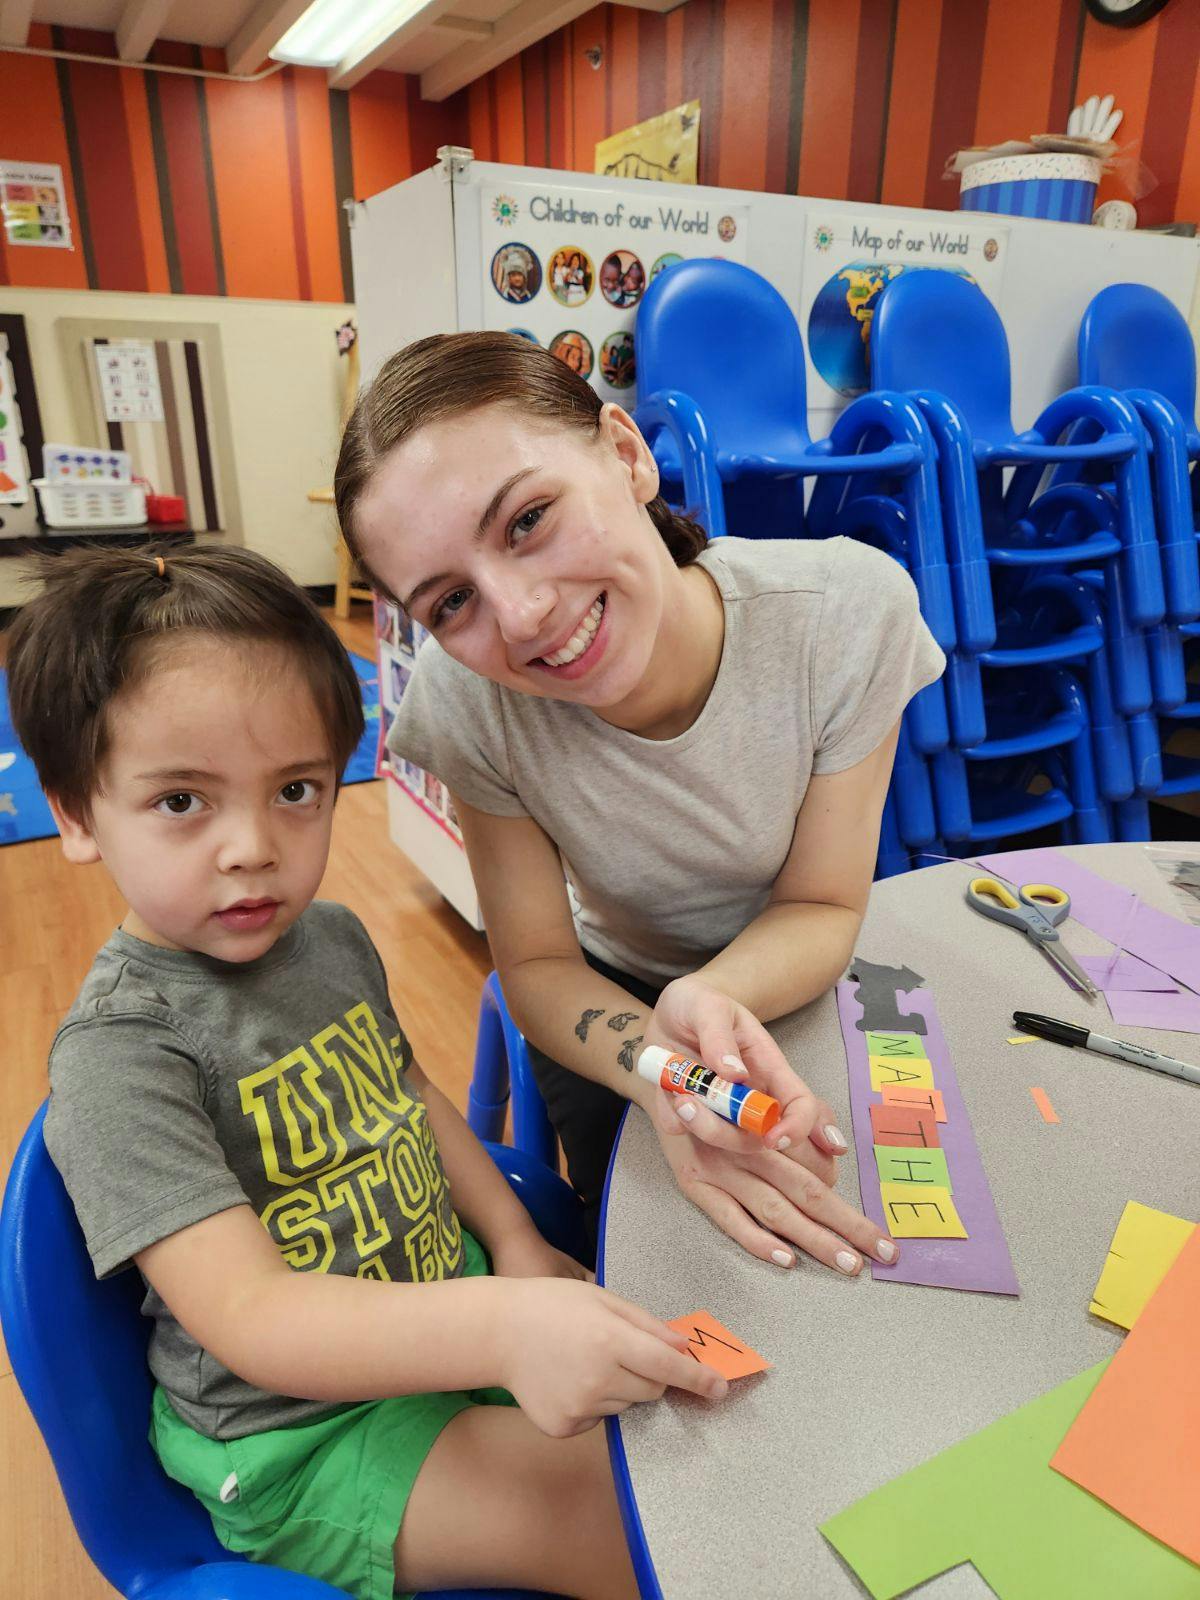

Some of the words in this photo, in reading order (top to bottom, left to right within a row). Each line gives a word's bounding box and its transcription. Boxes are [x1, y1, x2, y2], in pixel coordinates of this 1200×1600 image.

[529, 196, 599, 227] Children
[604, 203, 625, 228] of
[629, 215, 652, 230] our
[658, 206, 709, 235] World
[852, 226, 882, 257] Map
[887, 229, 904, 250] of
[906, 240, 925, 252] our
[929, 232, 969, 255] World
